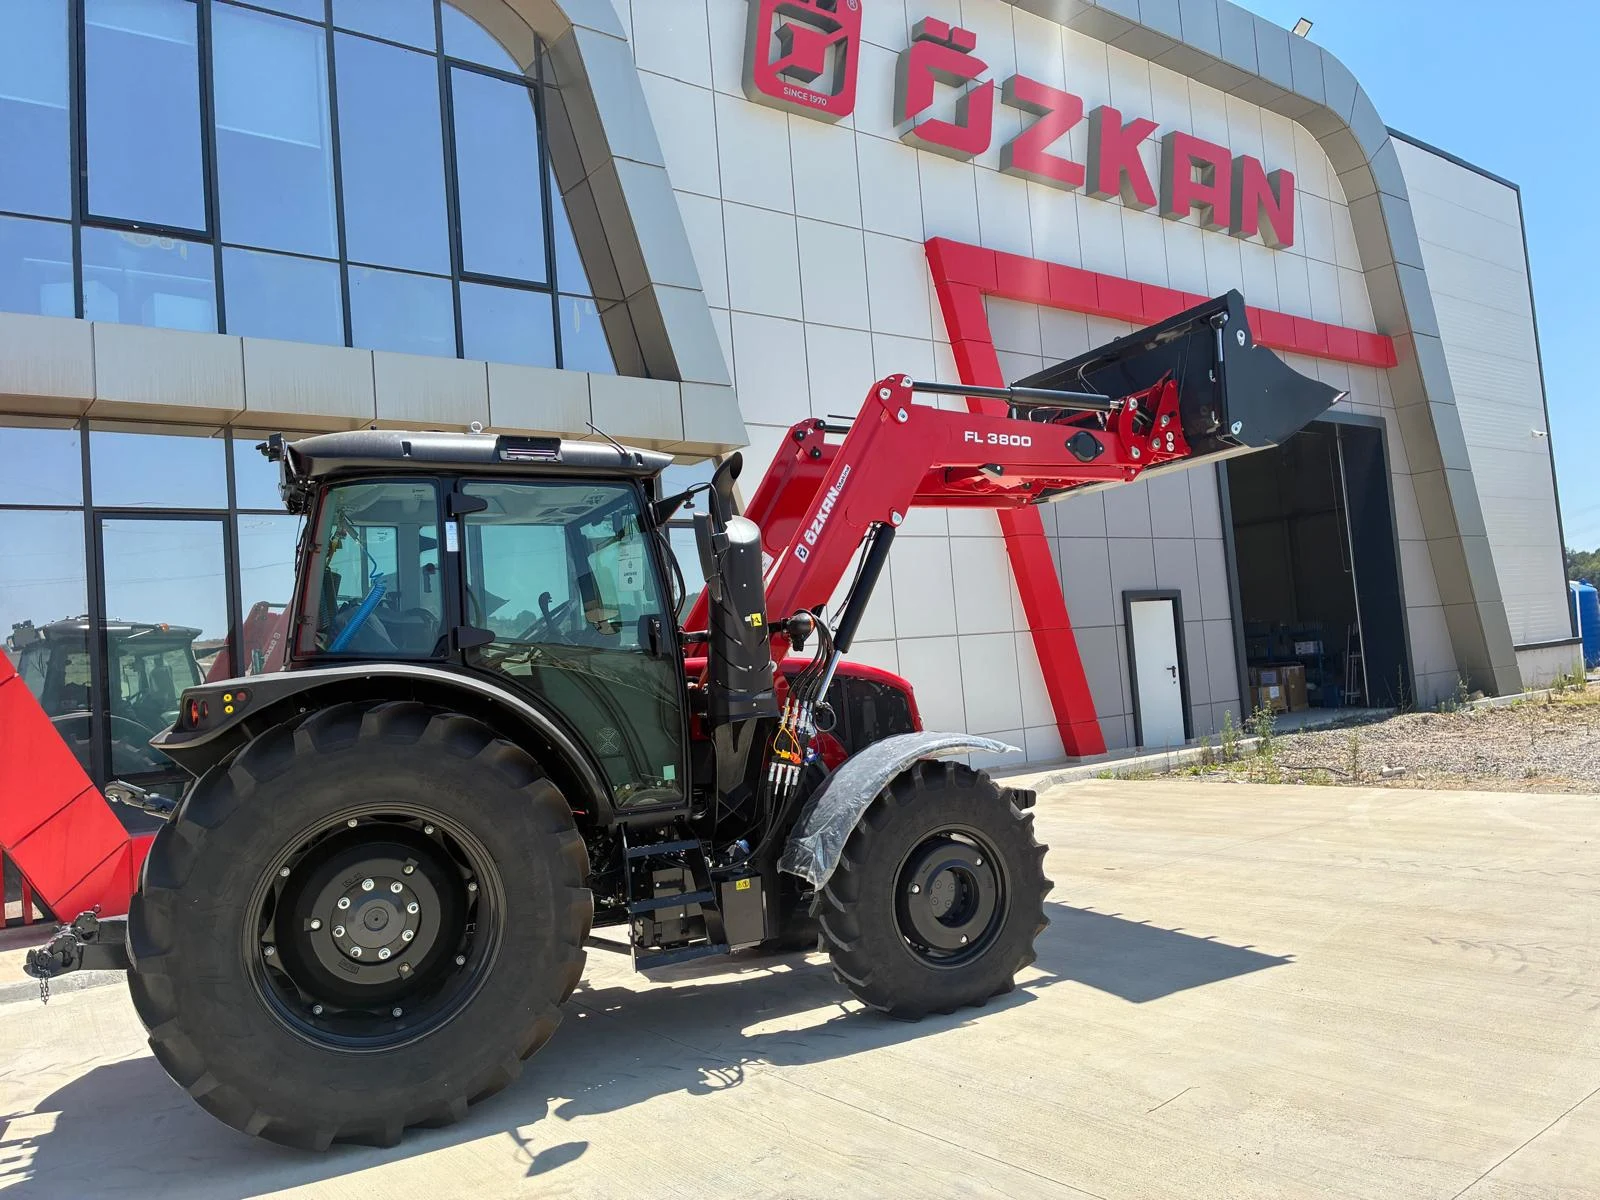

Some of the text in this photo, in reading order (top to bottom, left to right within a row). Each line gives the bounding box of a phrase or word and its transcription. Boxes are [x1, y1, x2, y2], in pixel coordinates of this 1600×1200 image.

[783, 87, 827, 106] SINCE 1970
[895, 16, 1294, 249] ÖZKAN
[964, 431, 1032, 447] FL 3800
[804, 485, 840, 546] ÖZKAN
